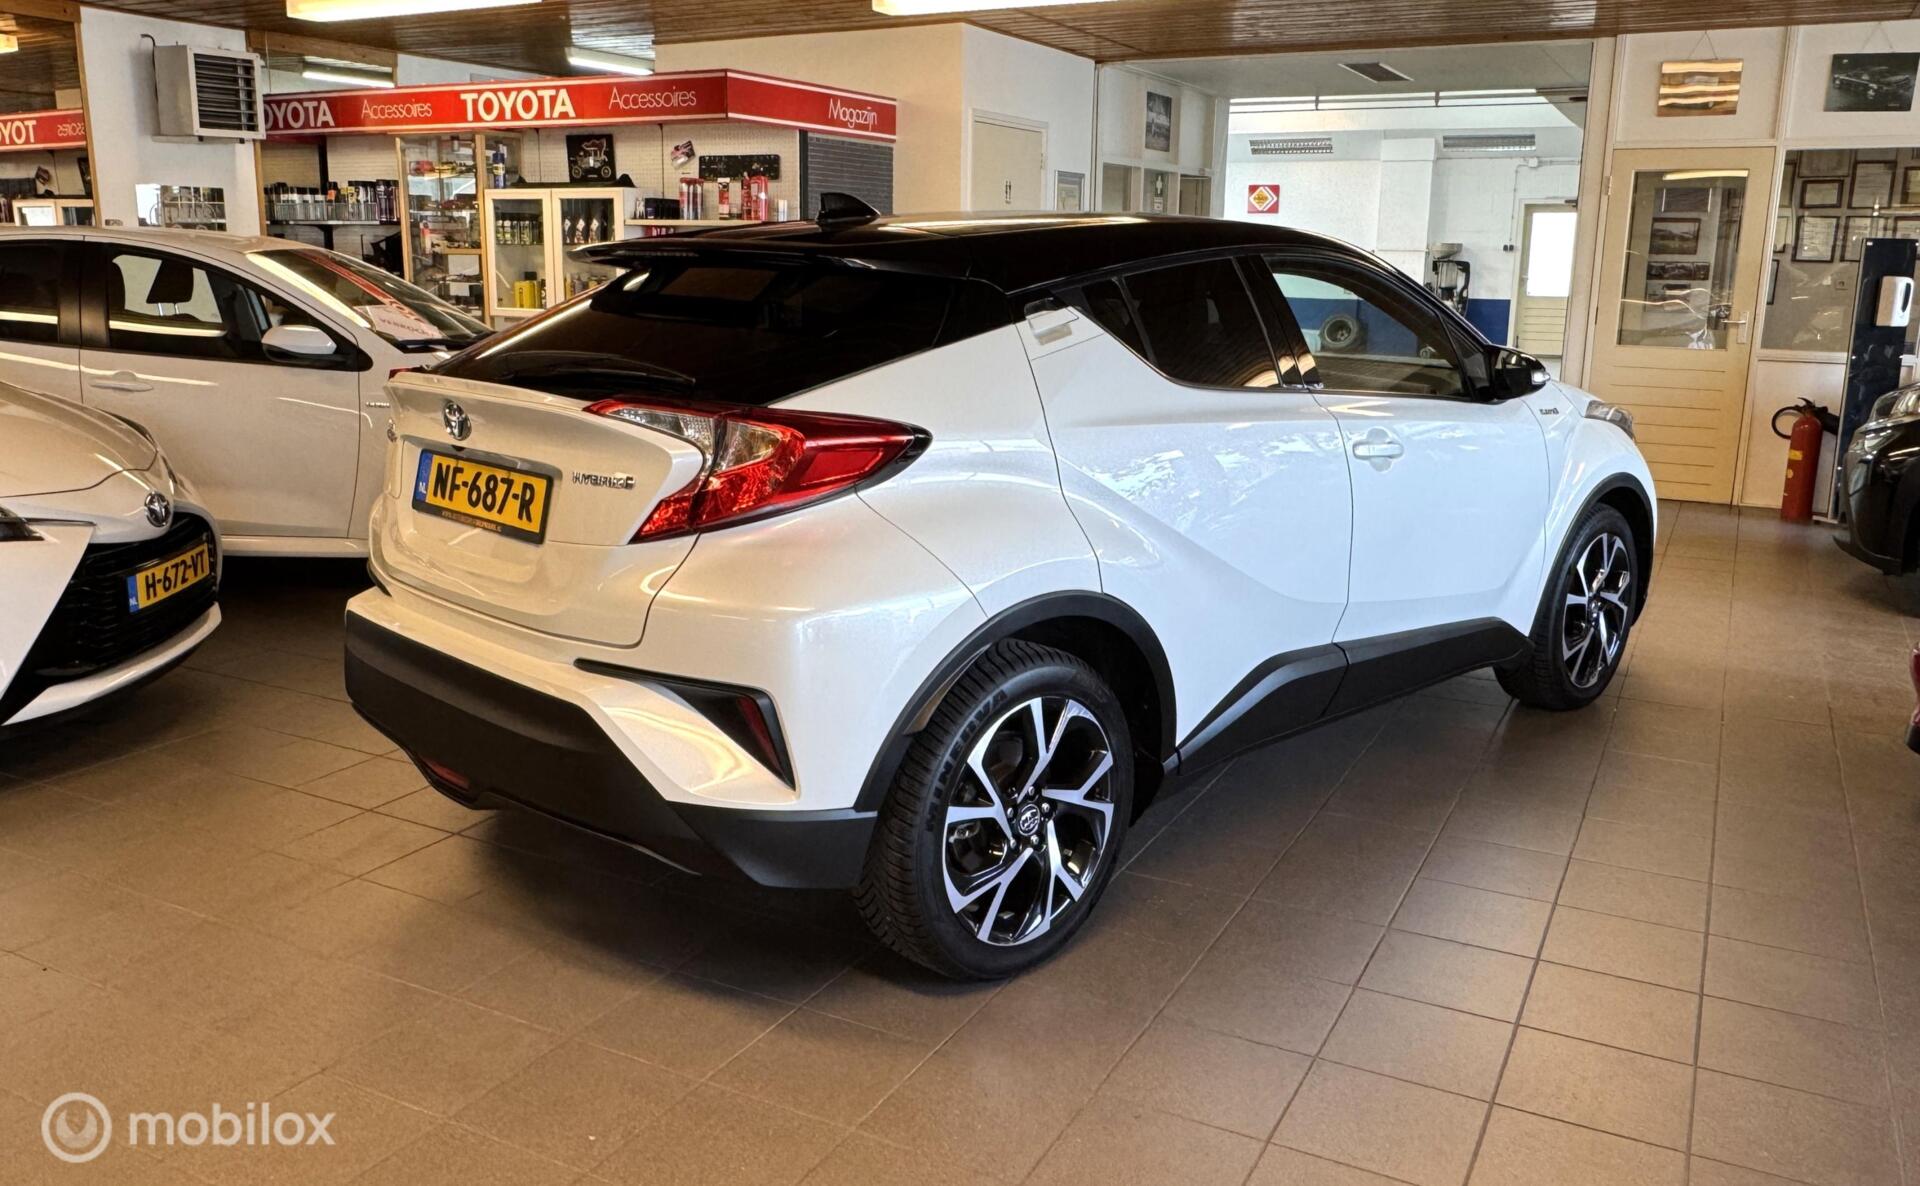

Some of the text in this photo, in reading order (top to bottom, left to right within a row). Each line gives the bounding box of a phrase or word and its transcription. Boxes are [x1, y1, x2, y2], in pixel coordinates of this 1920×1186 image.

[264, 86, 697, 129] OYOTA Accessoires TOYOTA Accessoires
[828, 98, 878, 132] Magazijn
[432, 462, 536, 523] NF-687-R
[145, 549, 205, 601] H-672-VT
[927, 688, 1009, 834] MINERVA
